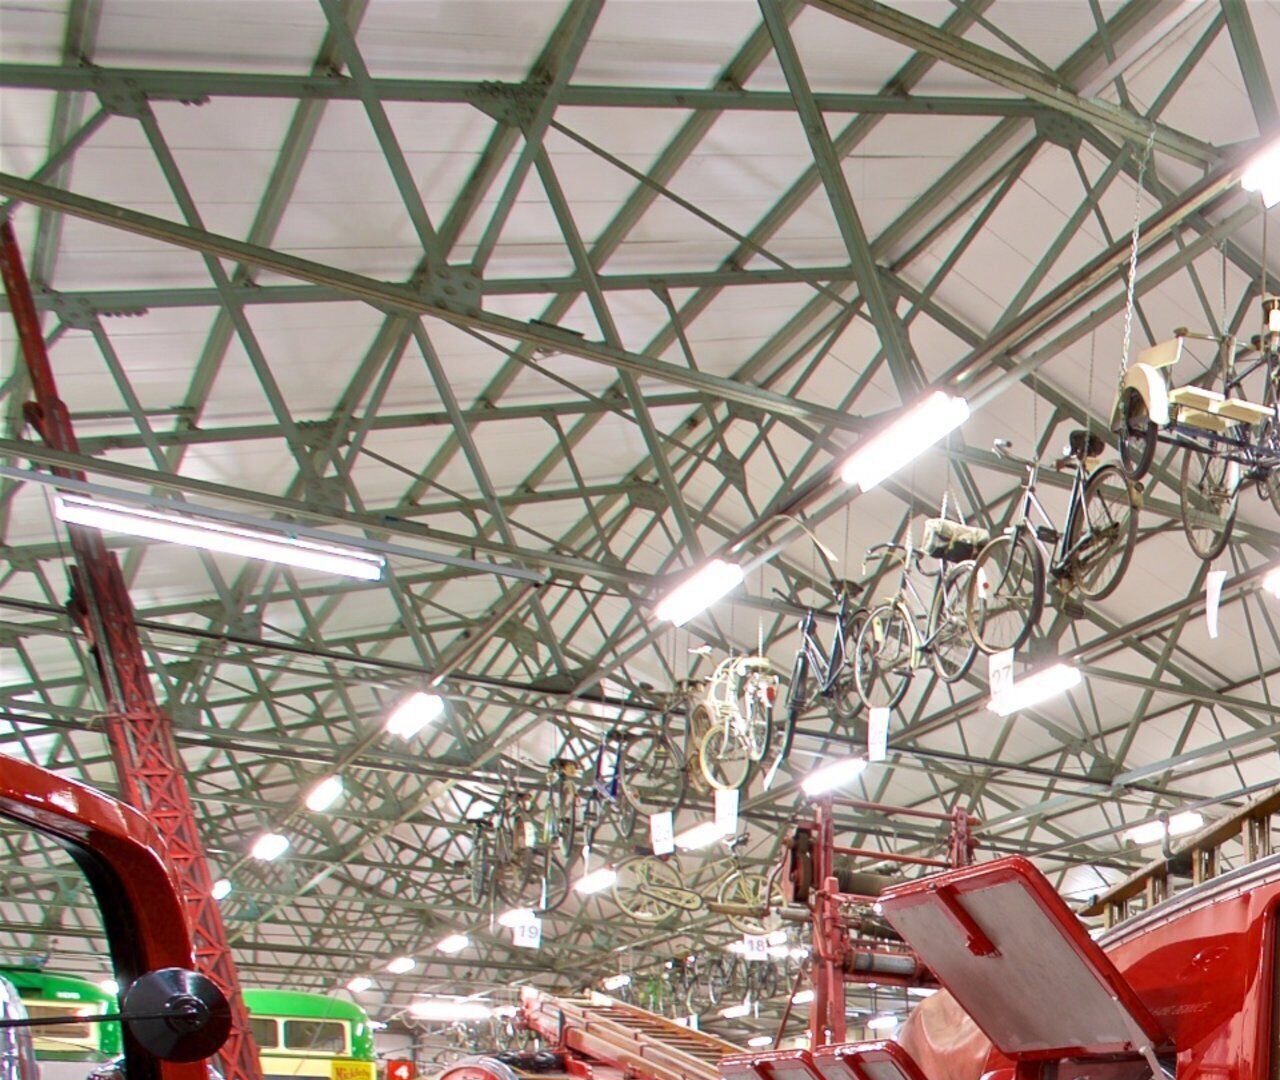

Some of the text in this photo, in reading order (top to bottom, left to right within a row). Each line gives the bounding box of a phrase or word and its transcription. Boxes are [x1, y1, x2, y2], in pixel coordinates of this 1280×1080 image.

[518, 925, 539, 940] 19
[747, 939, 765, 952] 18
[394, 1065, 409, 1080] 4
